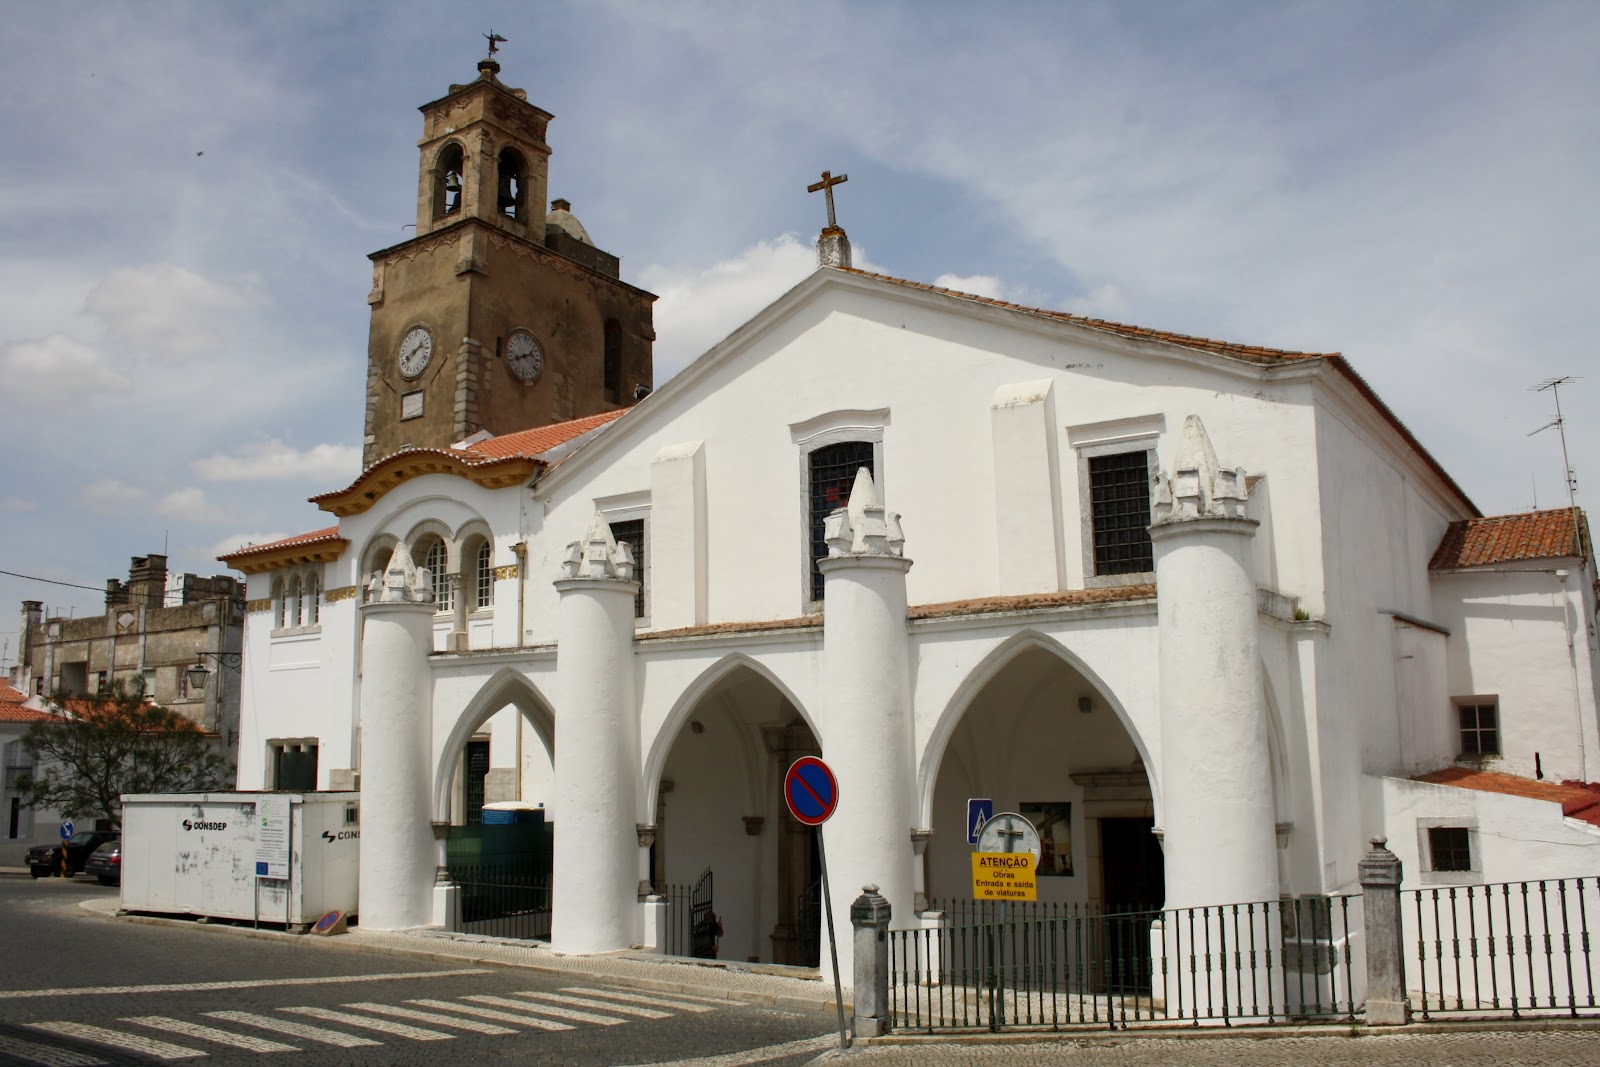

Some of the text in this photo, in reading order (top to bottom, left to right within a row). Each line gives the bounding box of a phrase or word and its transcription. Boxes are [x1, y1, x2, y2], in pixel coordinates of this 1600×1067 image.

[194, 822, 227, 831] CONSDEP
[980, 856, 1028, 868] ATENÇÃO
[996, 889, 1026, 897] viaturas
